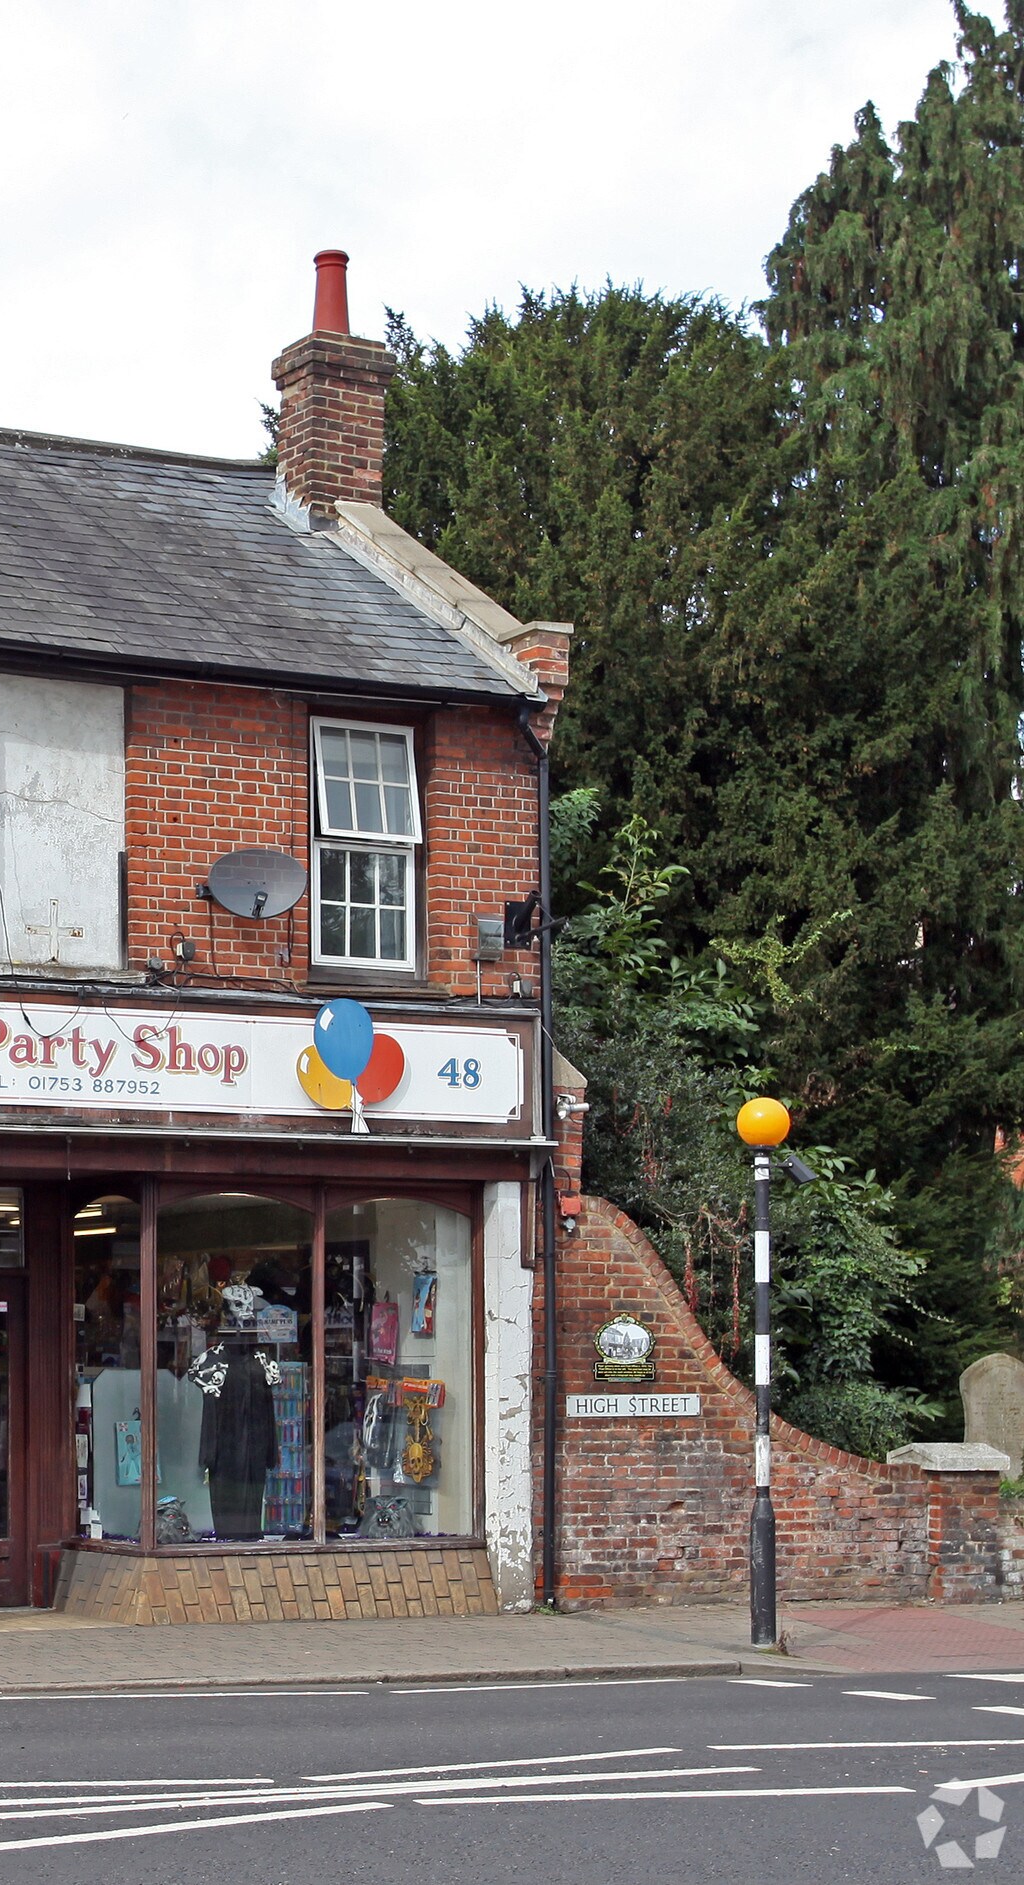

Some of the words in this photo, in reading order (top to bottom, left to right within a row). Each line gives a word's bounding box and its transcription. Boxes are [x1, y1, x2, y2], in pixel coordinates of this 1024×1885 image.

[131, 1023, 248, 1086] Shop
[28, 1076, 82, 1092] 01753
[92, 1078, 160, 1095] 887952
[437, 1057, 482, 1091] 48
[576, 1398, 618, 1414] HIGH
[628, 1397, 691, 1413] STREET
